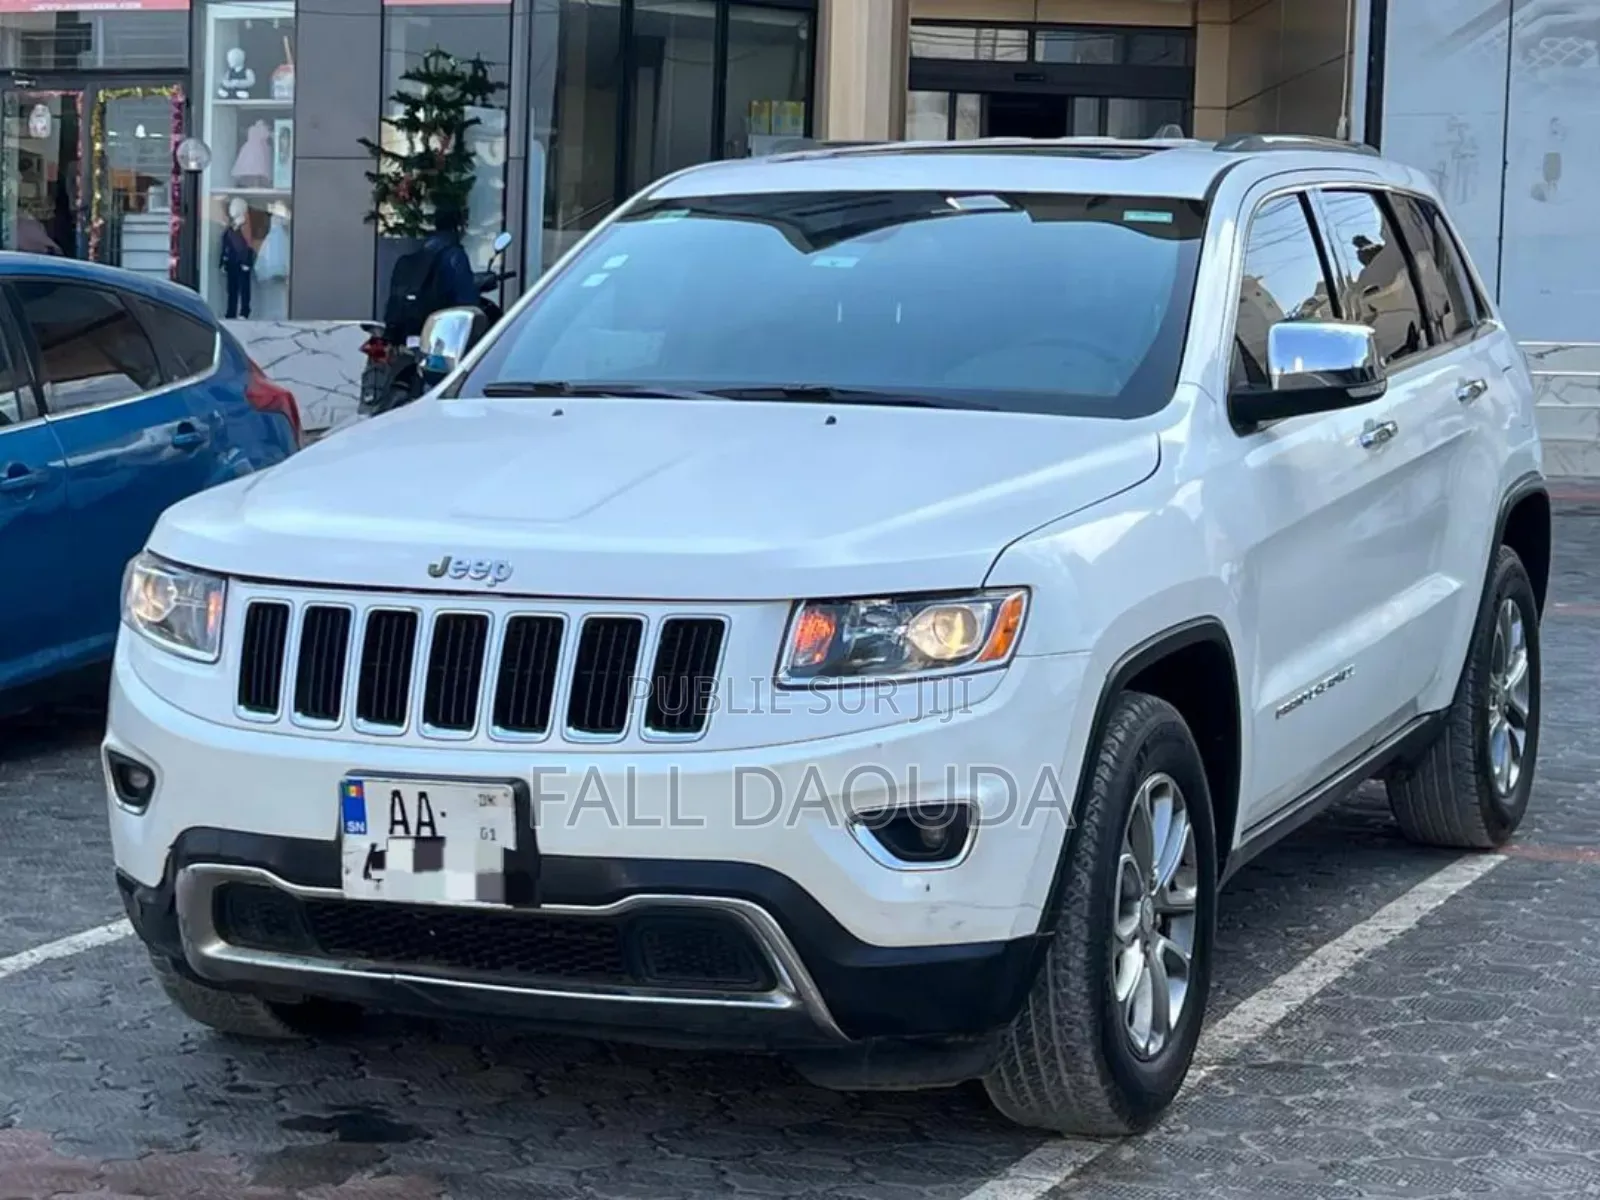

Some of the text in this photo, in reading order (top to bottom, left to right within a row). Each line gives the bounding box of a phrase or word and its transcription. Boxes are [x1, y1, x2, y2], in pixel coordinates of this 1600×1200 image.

[427, 556, 514, 588] Jeep
[346, 820, 366, 833] SN
[388, 789, 438, 837] AA
